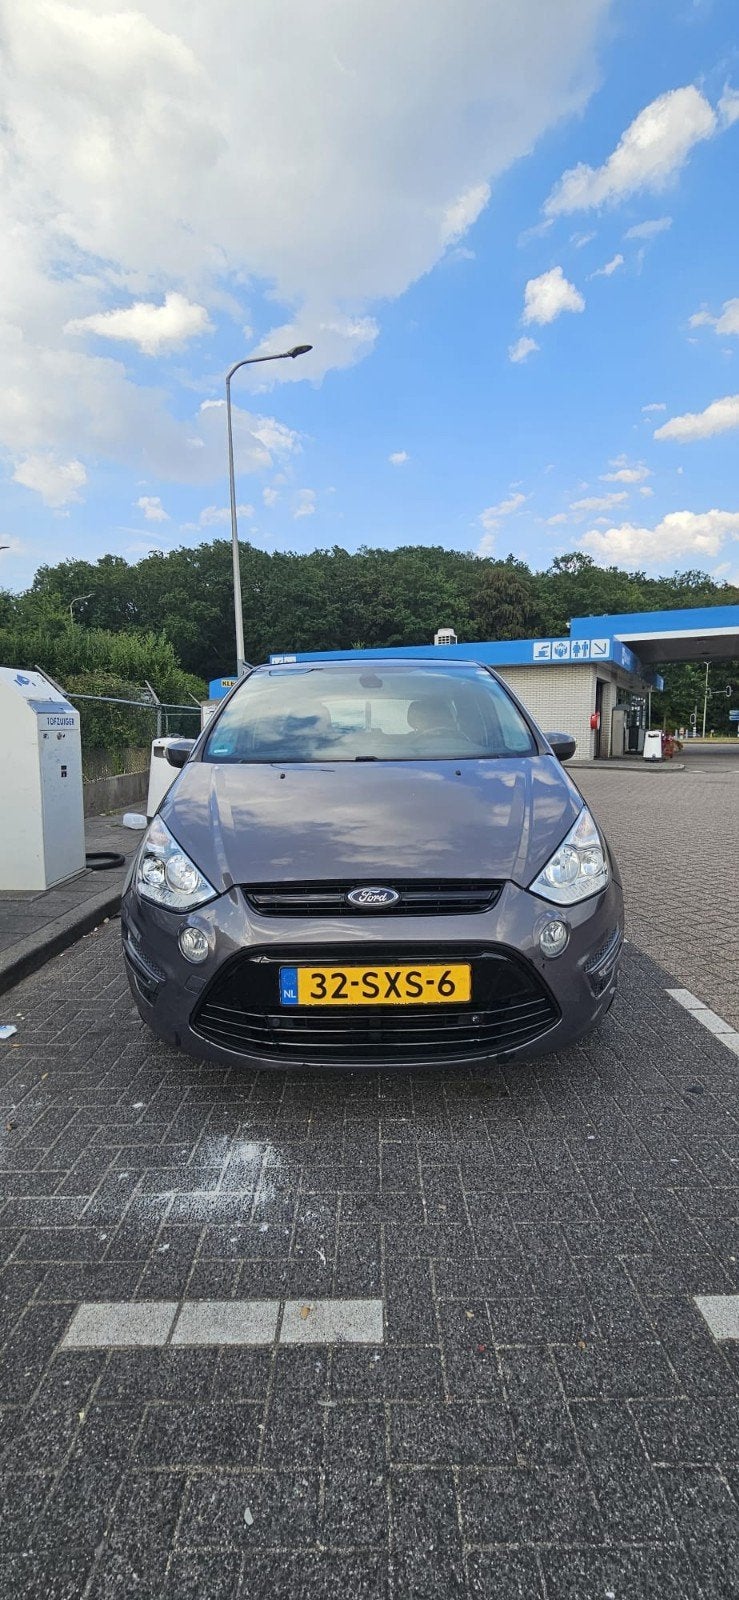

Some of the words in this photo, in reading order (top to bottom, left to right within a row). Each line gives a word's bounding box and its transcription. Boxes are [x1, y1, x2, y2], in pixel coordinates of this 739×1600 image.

[359, 890, 388, 902] Ford
[283, 990, 296, 999] NL
[310, 970, 456, 999] 32-SXS-6
